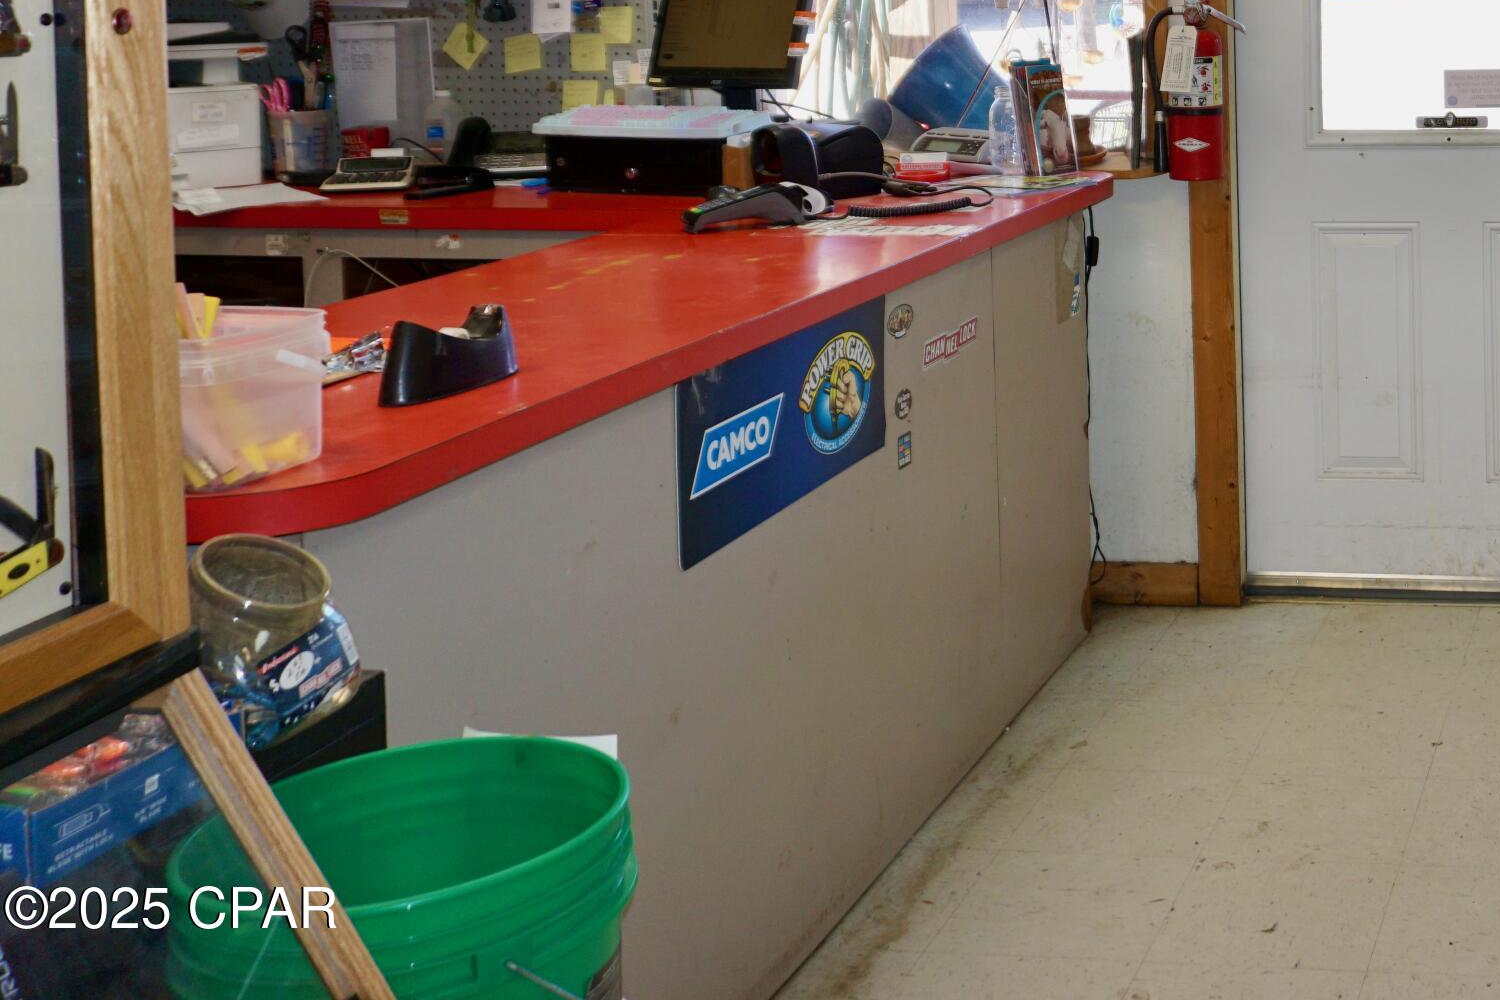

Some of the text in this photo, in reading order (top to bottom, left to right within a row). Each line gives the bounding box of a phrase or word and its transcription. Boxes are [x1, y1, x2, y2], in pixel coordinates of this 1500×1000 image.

[801, 338, 844, 407] POWER
[846, 335, 873, 371] GRIP
[706, 416, 770, 471] CAMCO
